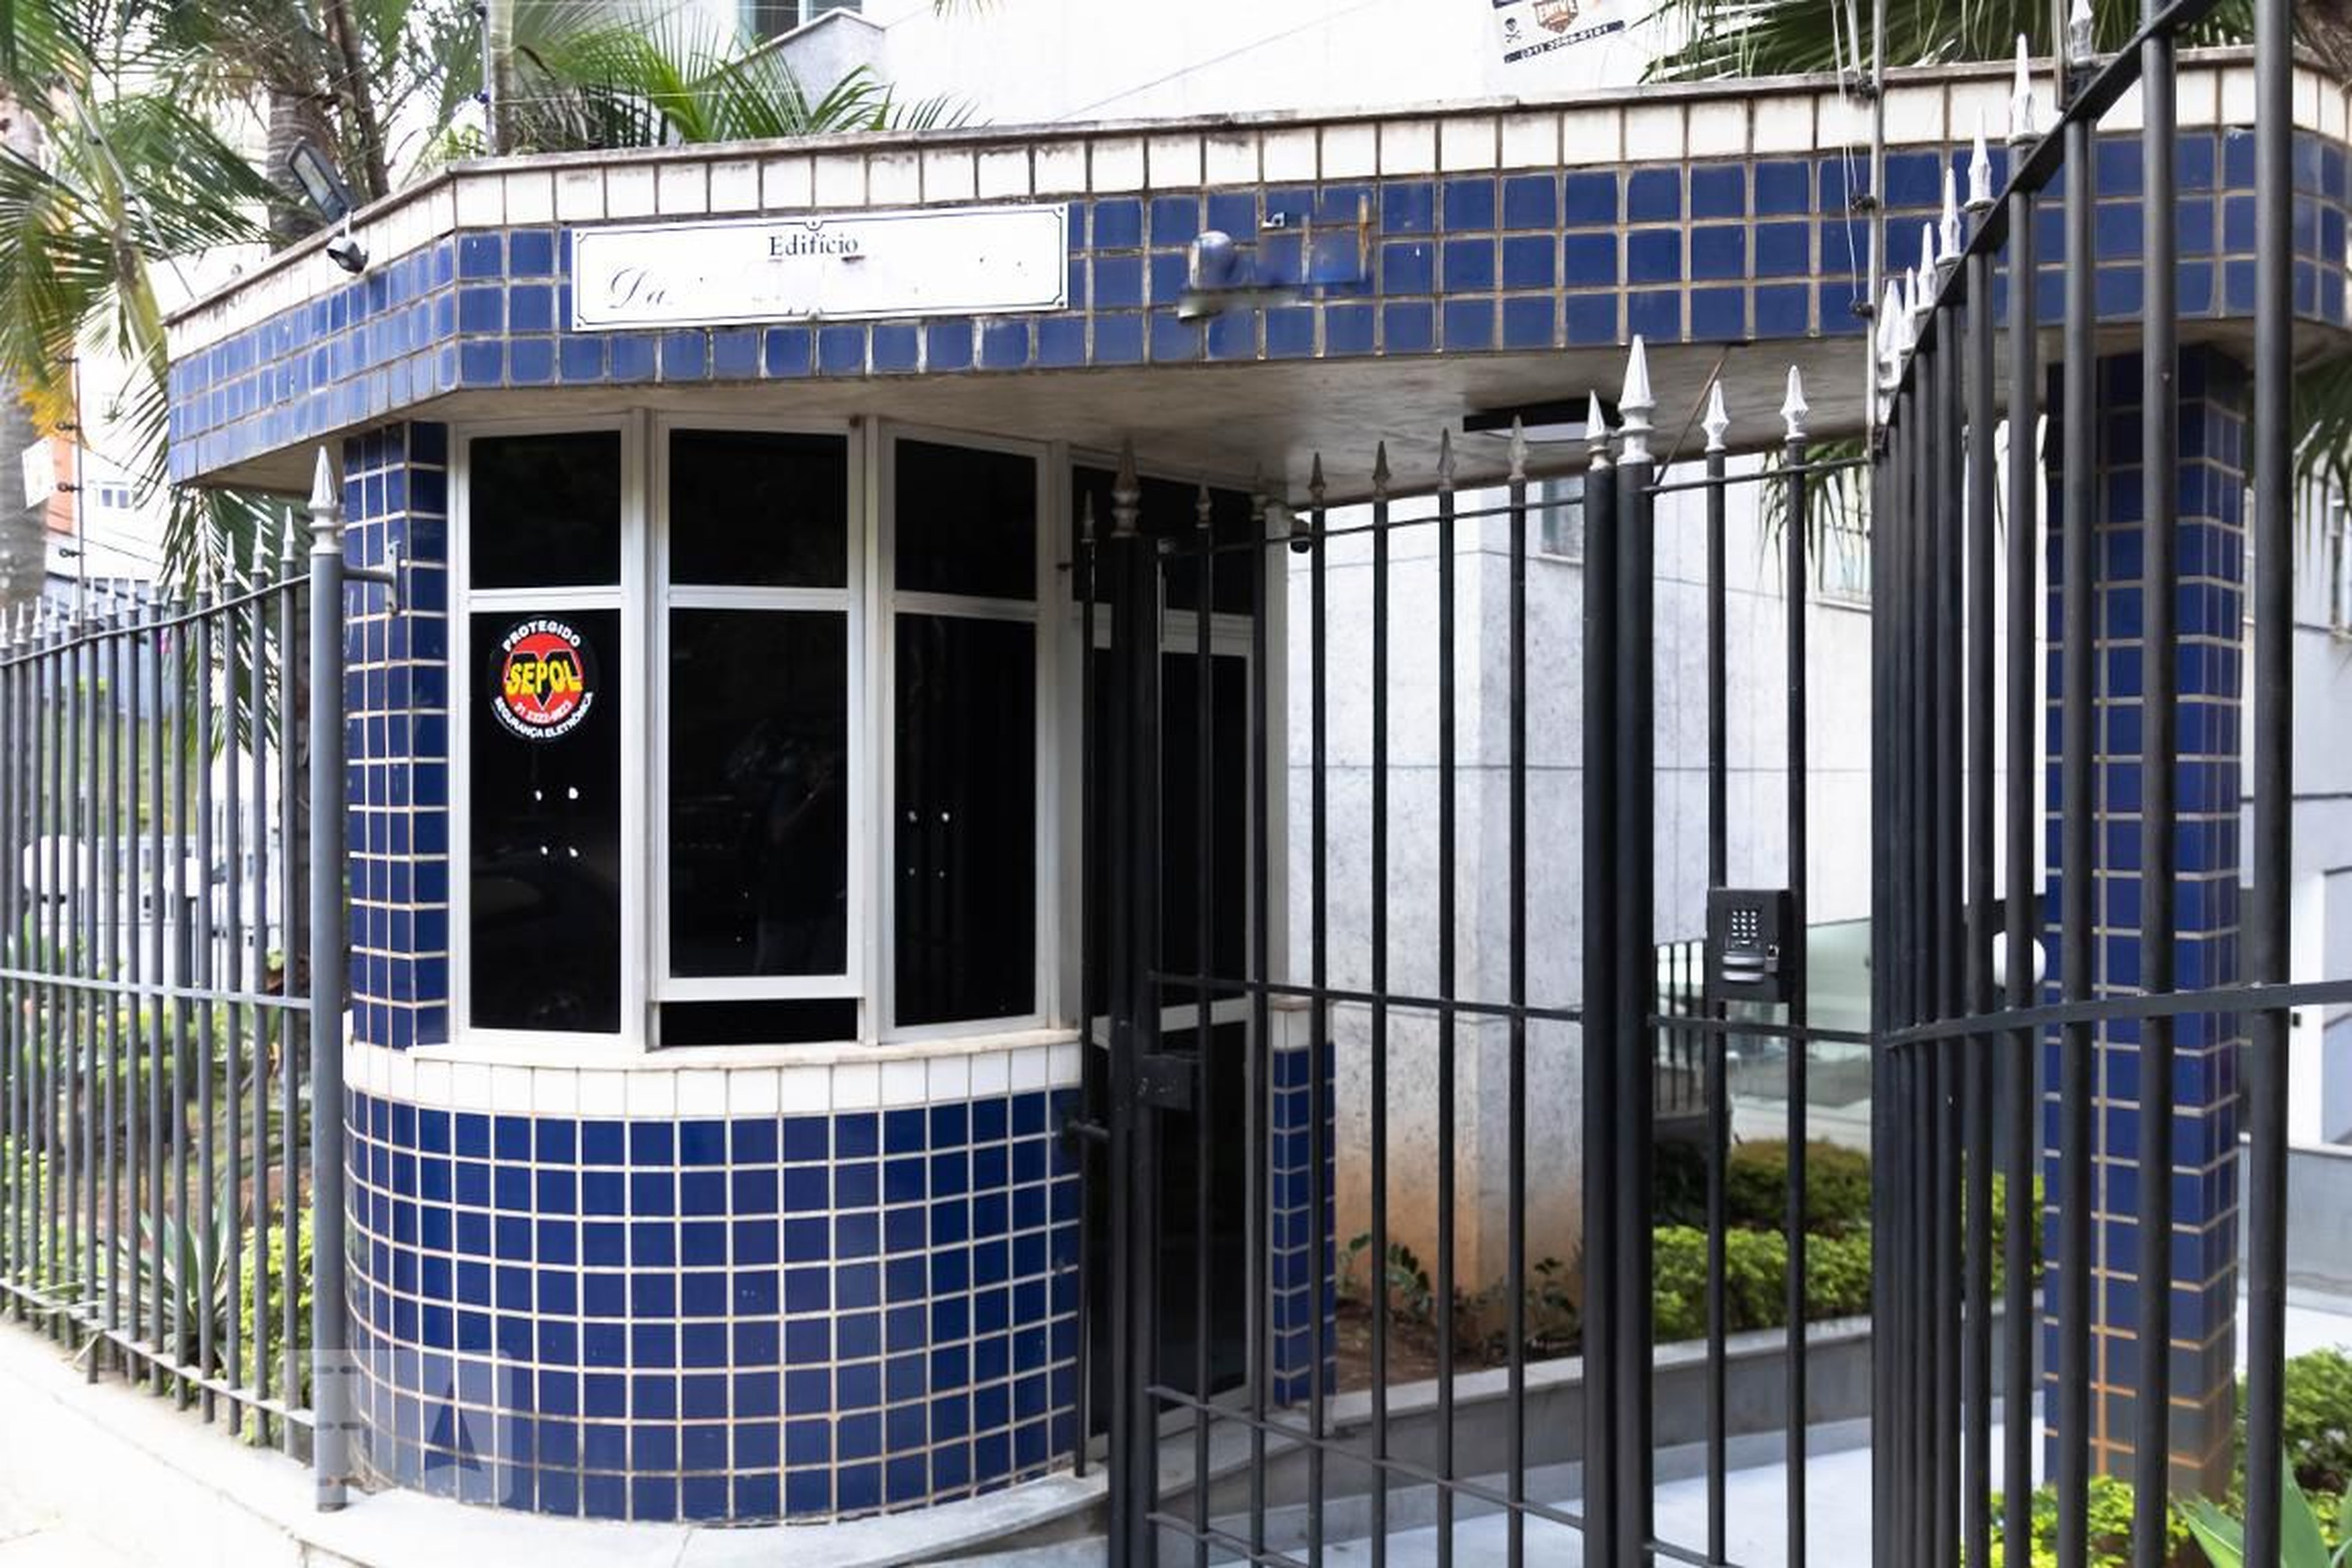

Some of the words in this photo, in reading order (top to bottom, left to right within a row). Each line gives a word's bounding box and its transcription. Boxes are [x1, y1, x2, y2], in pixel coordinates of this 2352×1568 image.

[769, 232, 859, 256] Edifício
[502, 620, 581, 652] PROTEGIDO
[505, 659, 584, 696] SEPOL
[494, 697, 545, 739] SEGURANÇA
